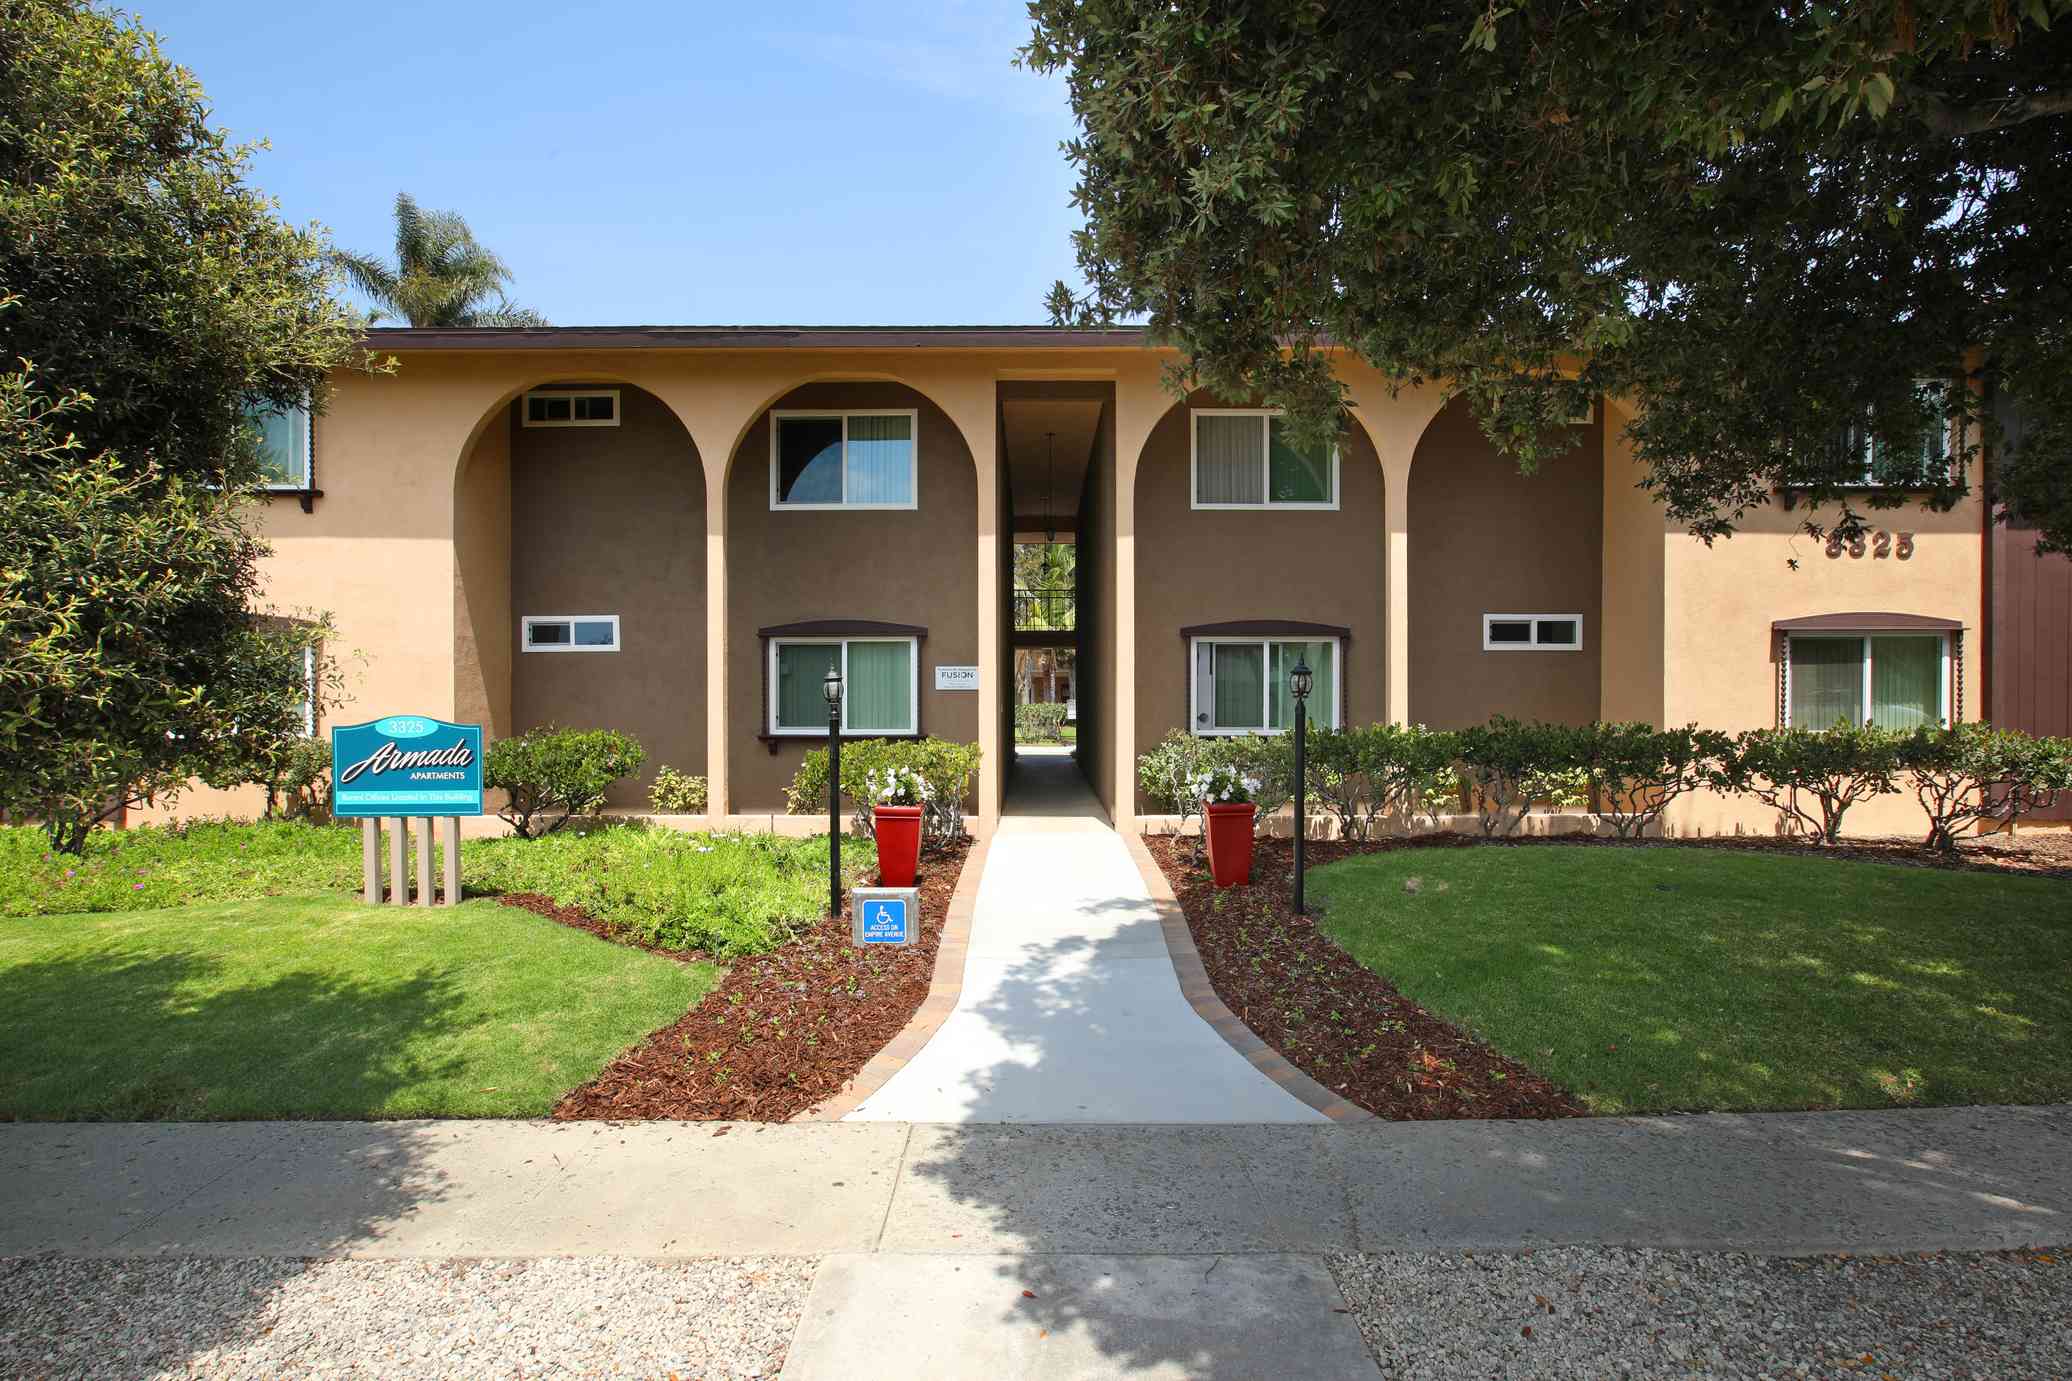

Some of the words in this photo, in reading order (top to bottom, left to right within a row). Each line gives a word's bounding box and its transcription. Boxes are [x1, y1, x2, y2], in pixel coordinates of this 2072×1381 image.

[941, 671, 975, 679] FUSION
[389, 720, 424, 733] 3325
[341, 738, 473, 783] Armada
[410, 771, 465, 780] APARTMENTS
